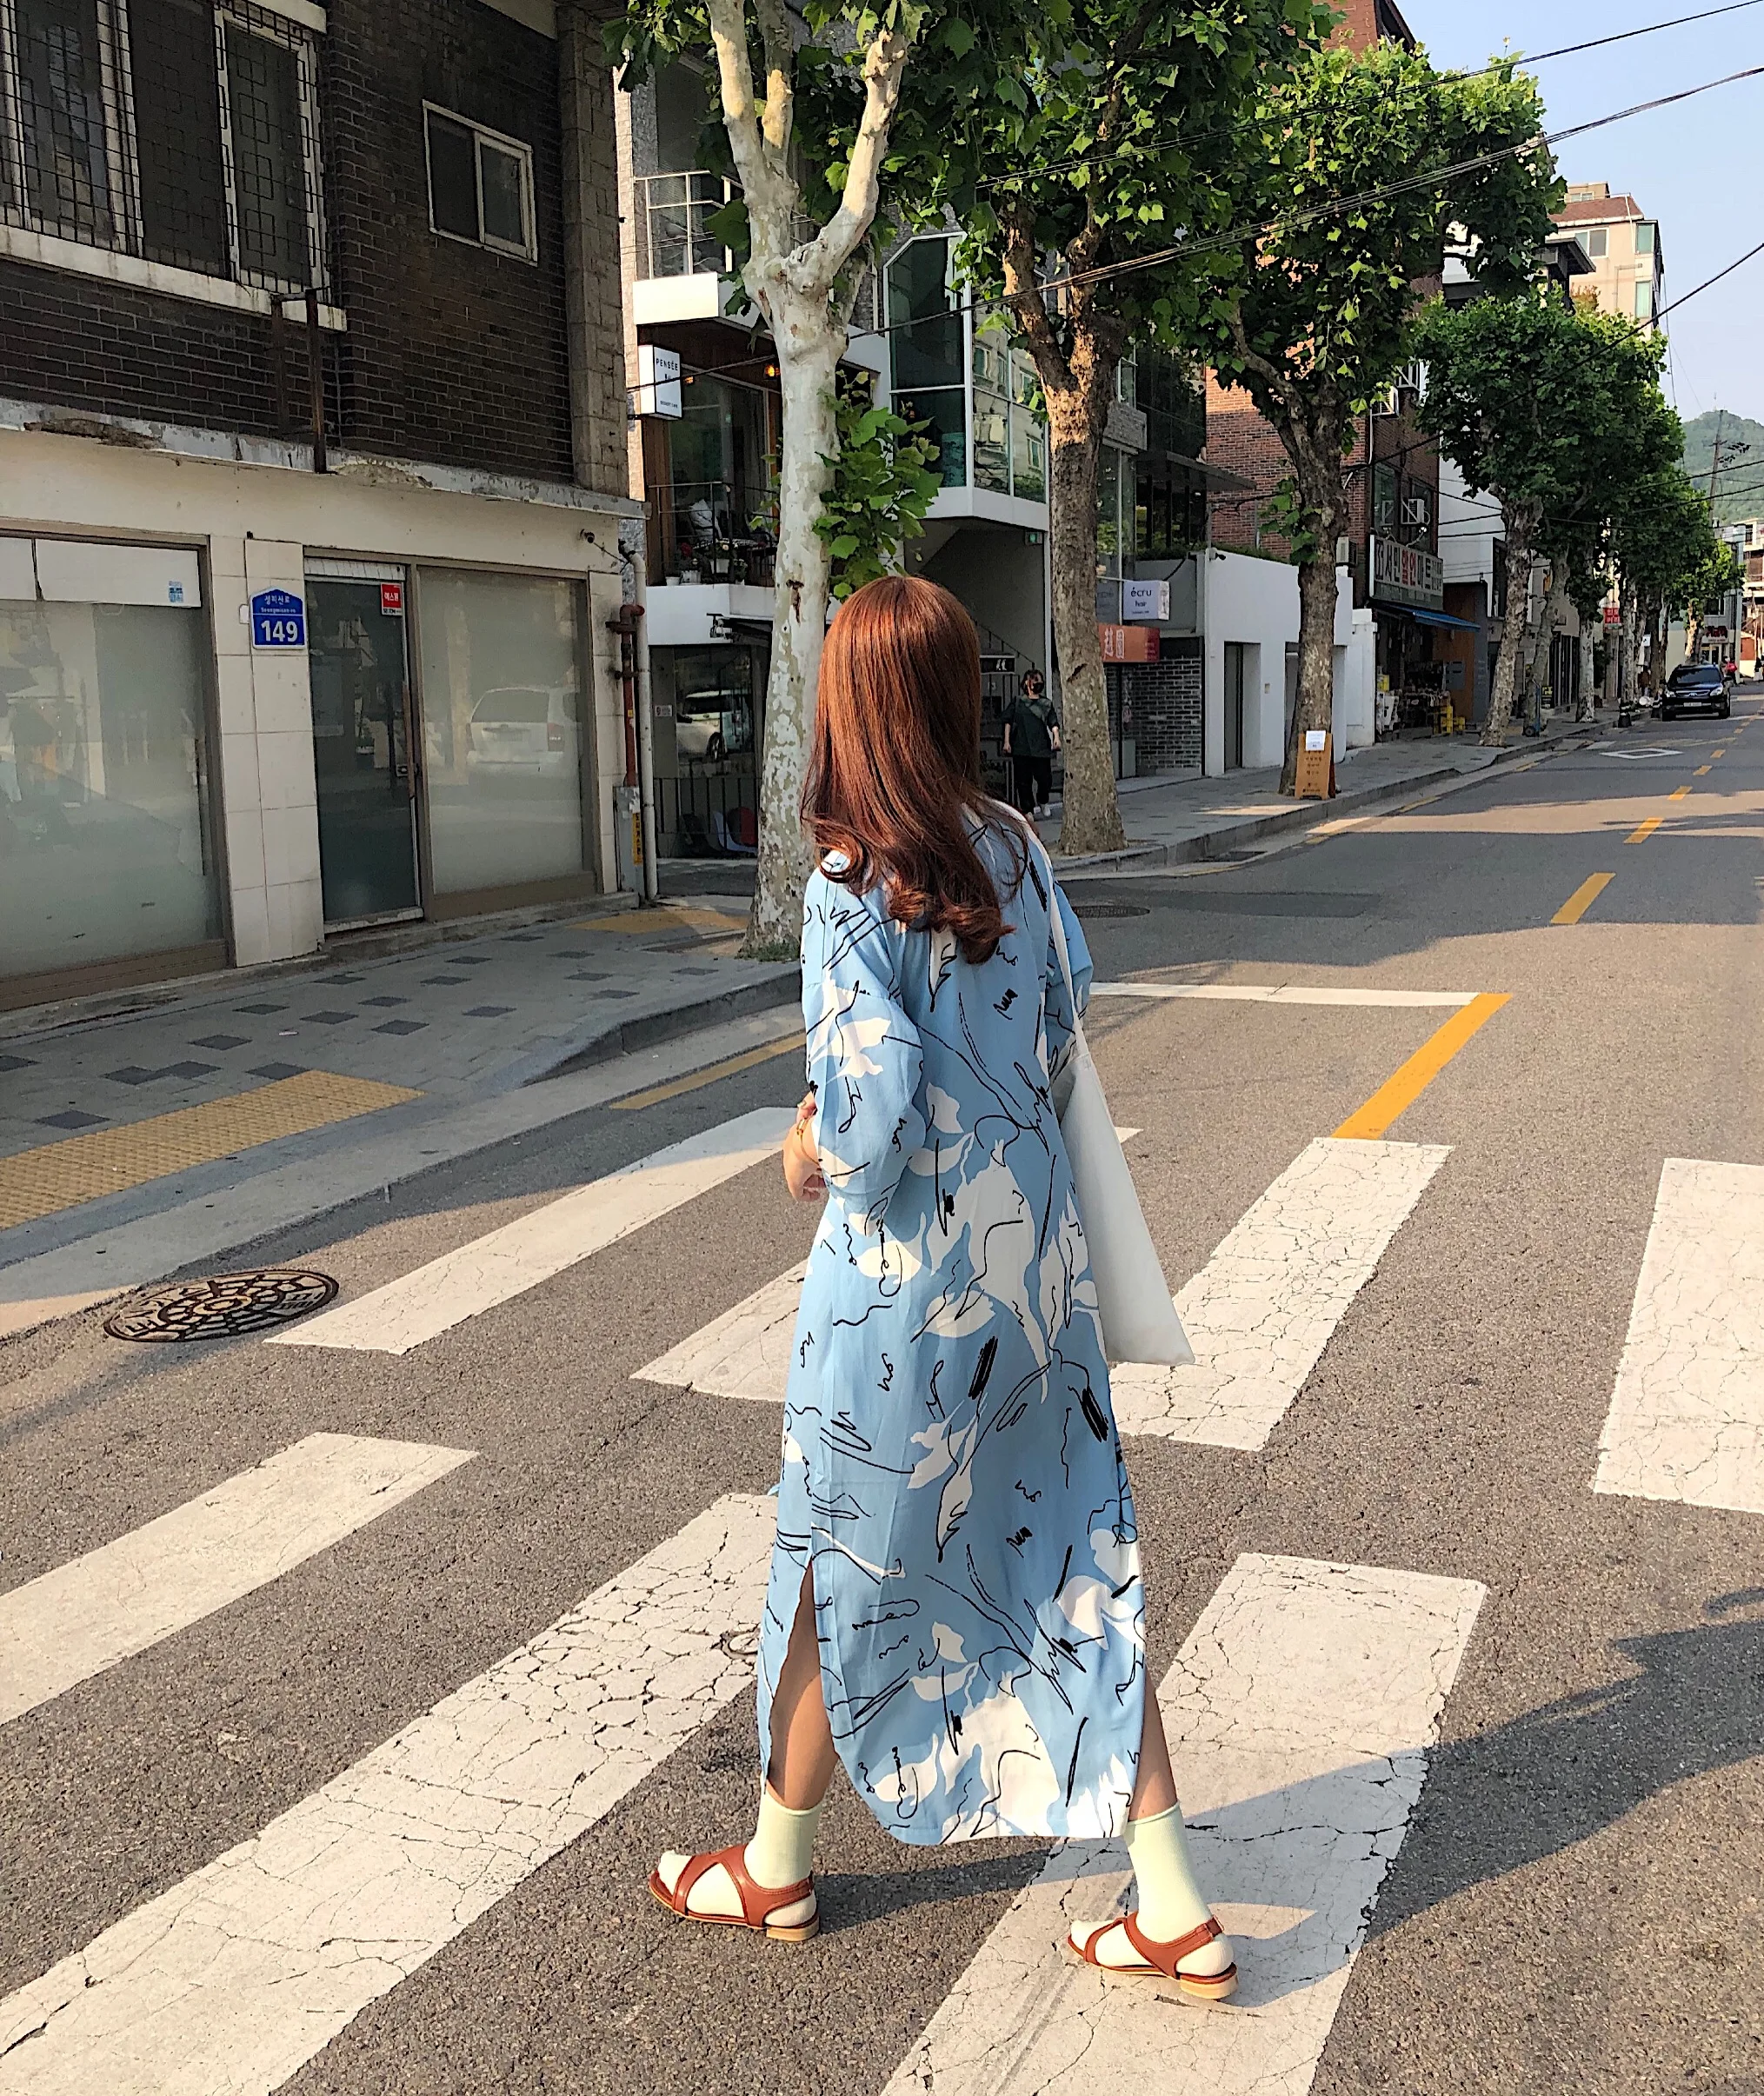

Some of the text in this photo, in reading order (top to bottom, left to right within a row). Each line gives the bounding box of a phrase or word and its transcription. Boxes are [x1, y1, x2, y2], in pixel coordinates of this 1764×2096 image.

[656, 357, 679, 371] PENSÉE
[1130, 587, 1152, 597] écru
[264, 595, 290, 606] 성미산로
[261, 620, 298, 642] 149
